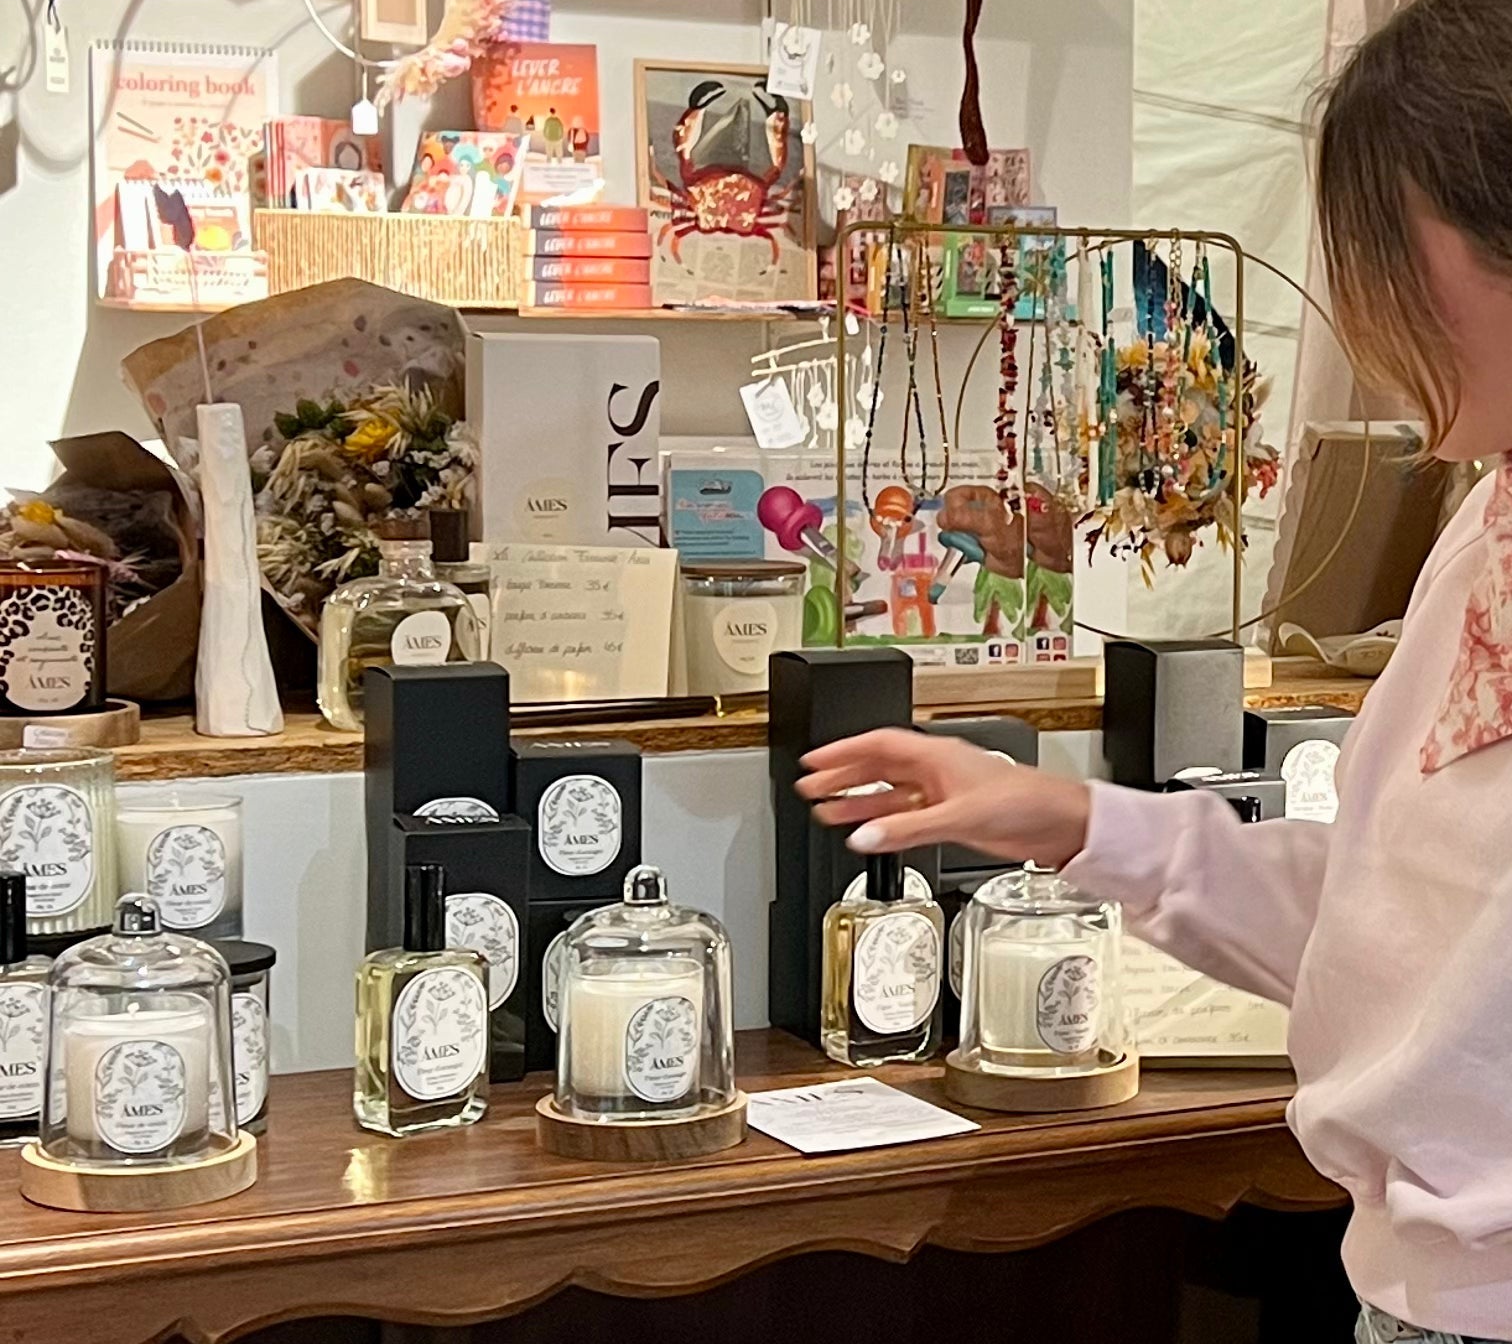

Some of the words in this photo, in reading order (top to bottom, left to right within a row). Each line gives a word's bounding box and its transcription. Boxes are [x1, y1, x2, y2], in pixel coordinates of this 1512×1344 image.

[115, 72, 200, 97] coloring
[205, 75, 255, 95] book
[122, 1103, 164, 1118] ÂMES
